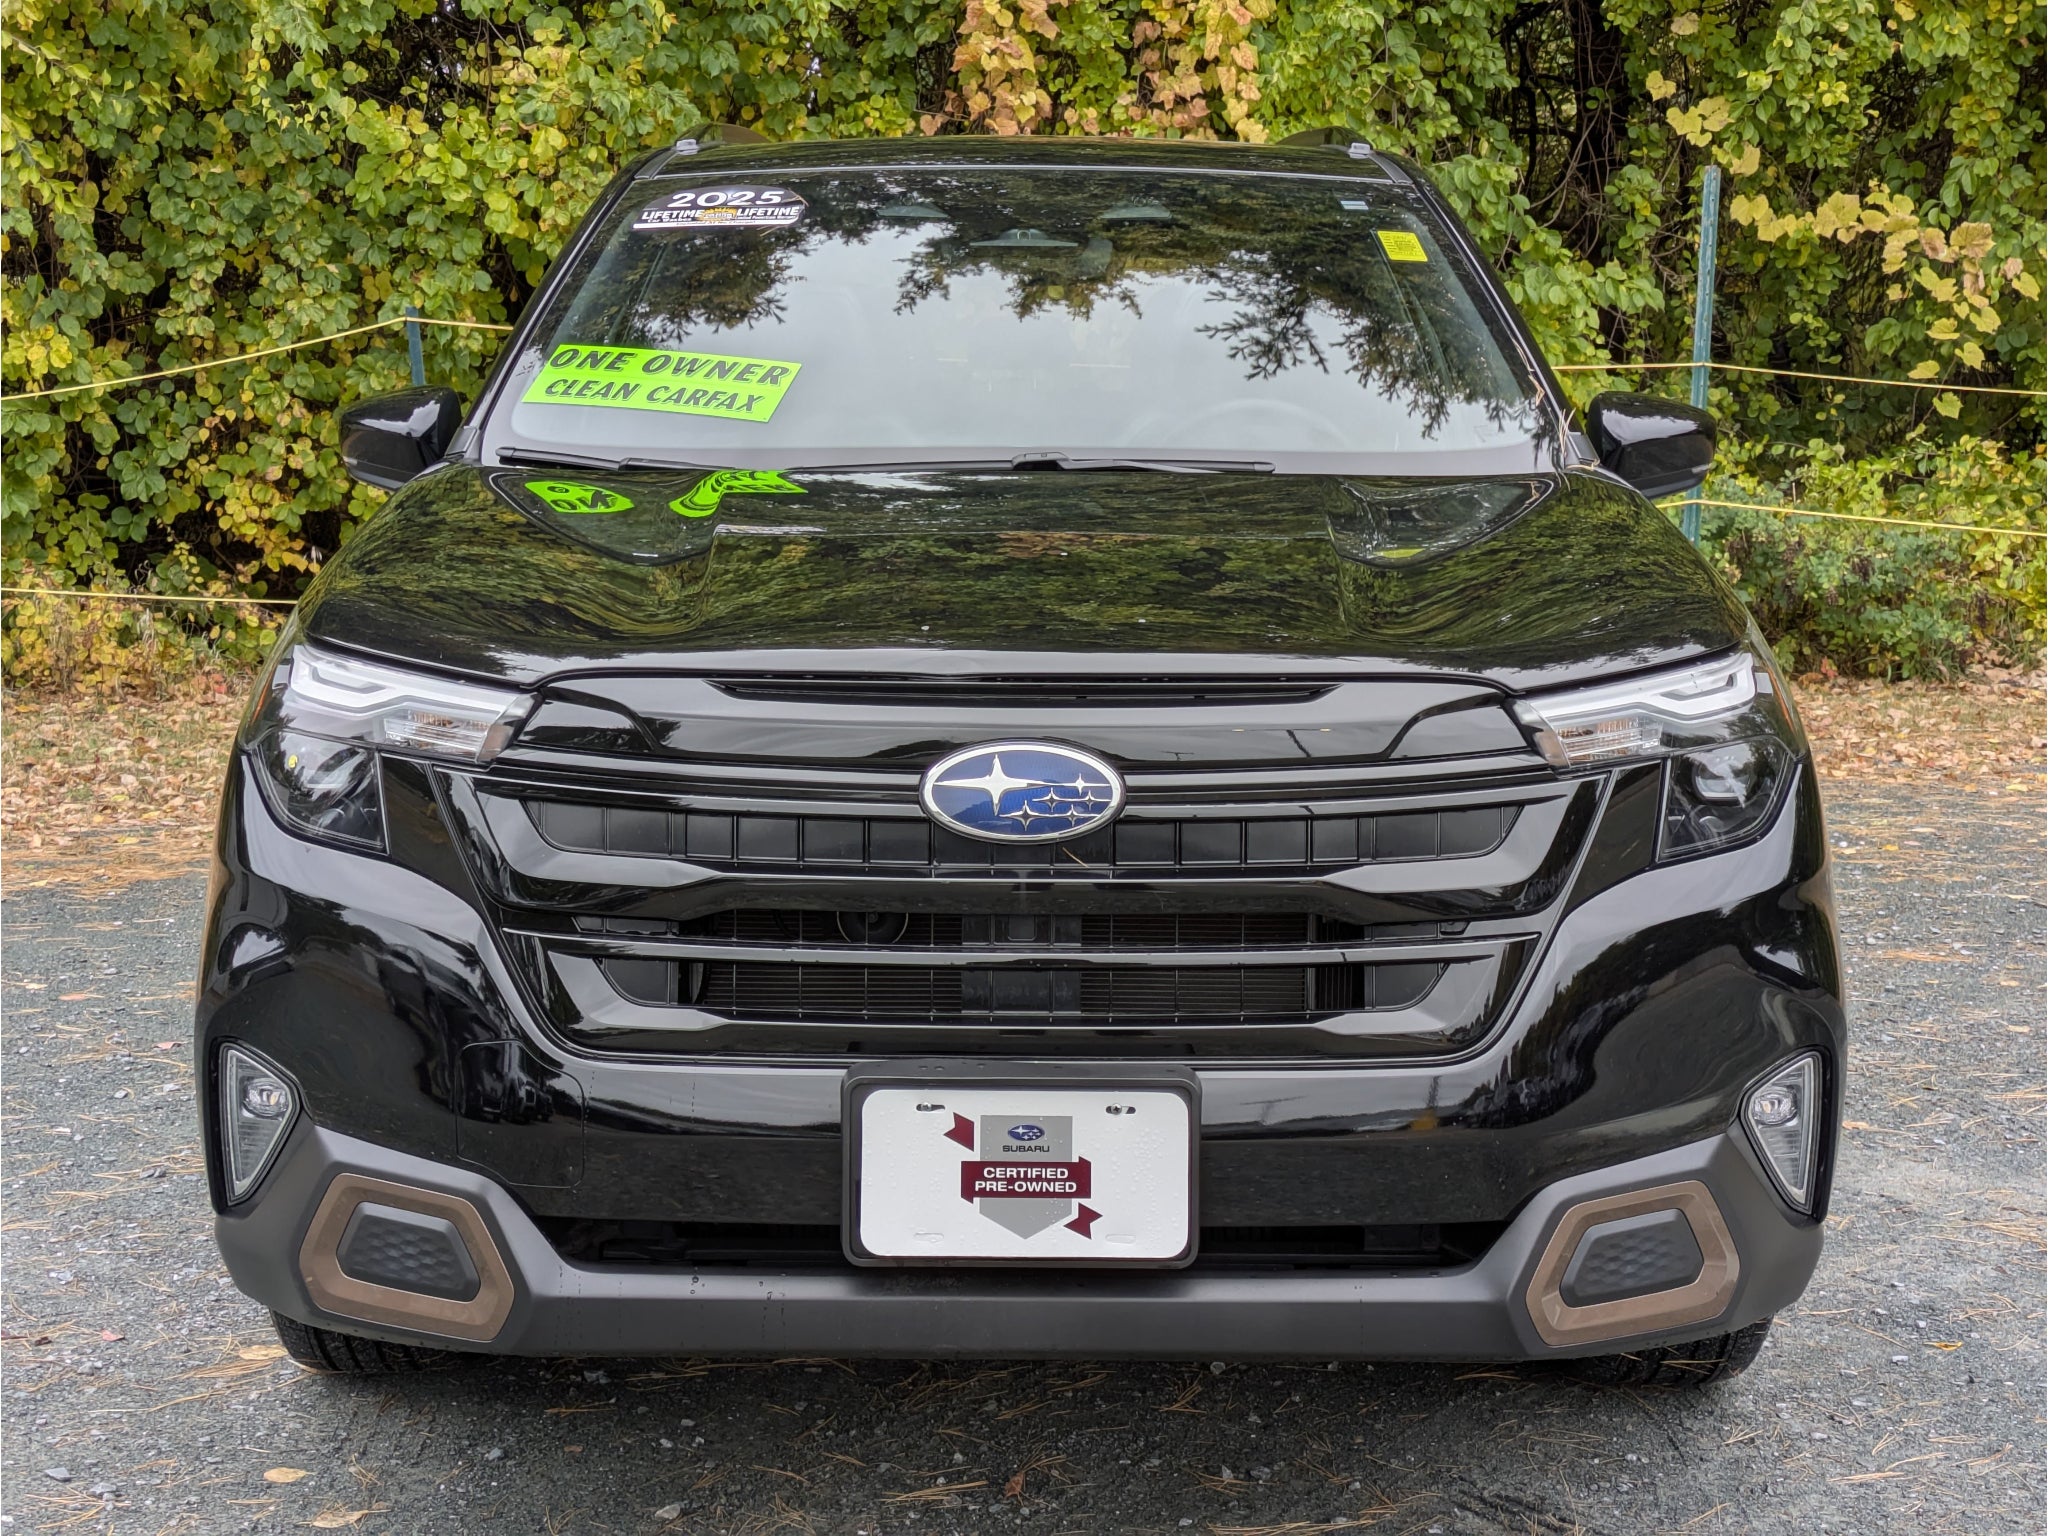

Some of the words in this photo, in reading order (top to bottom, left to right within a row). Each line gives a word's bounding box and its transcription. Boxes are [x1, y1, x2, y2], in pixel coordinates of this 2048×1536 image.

[667, 191, 785, 208] 2025
[641, 209, 705, 220] LIFETIME
[736, 206, 800, 216] LIFETIME
[549, 348, 637, 371] ONE
[641, 354, 791, 386] OWNER
[544, 378, 641, 401] CLEAN
[646, 385, 765, 413] CARFAX
[1002, 1145, 1050, 1153] SUBARU
[983, 1167, 1069, 1179] CERTIFIED
[974, 1181, 1077, 1193] PRE-OWNED
